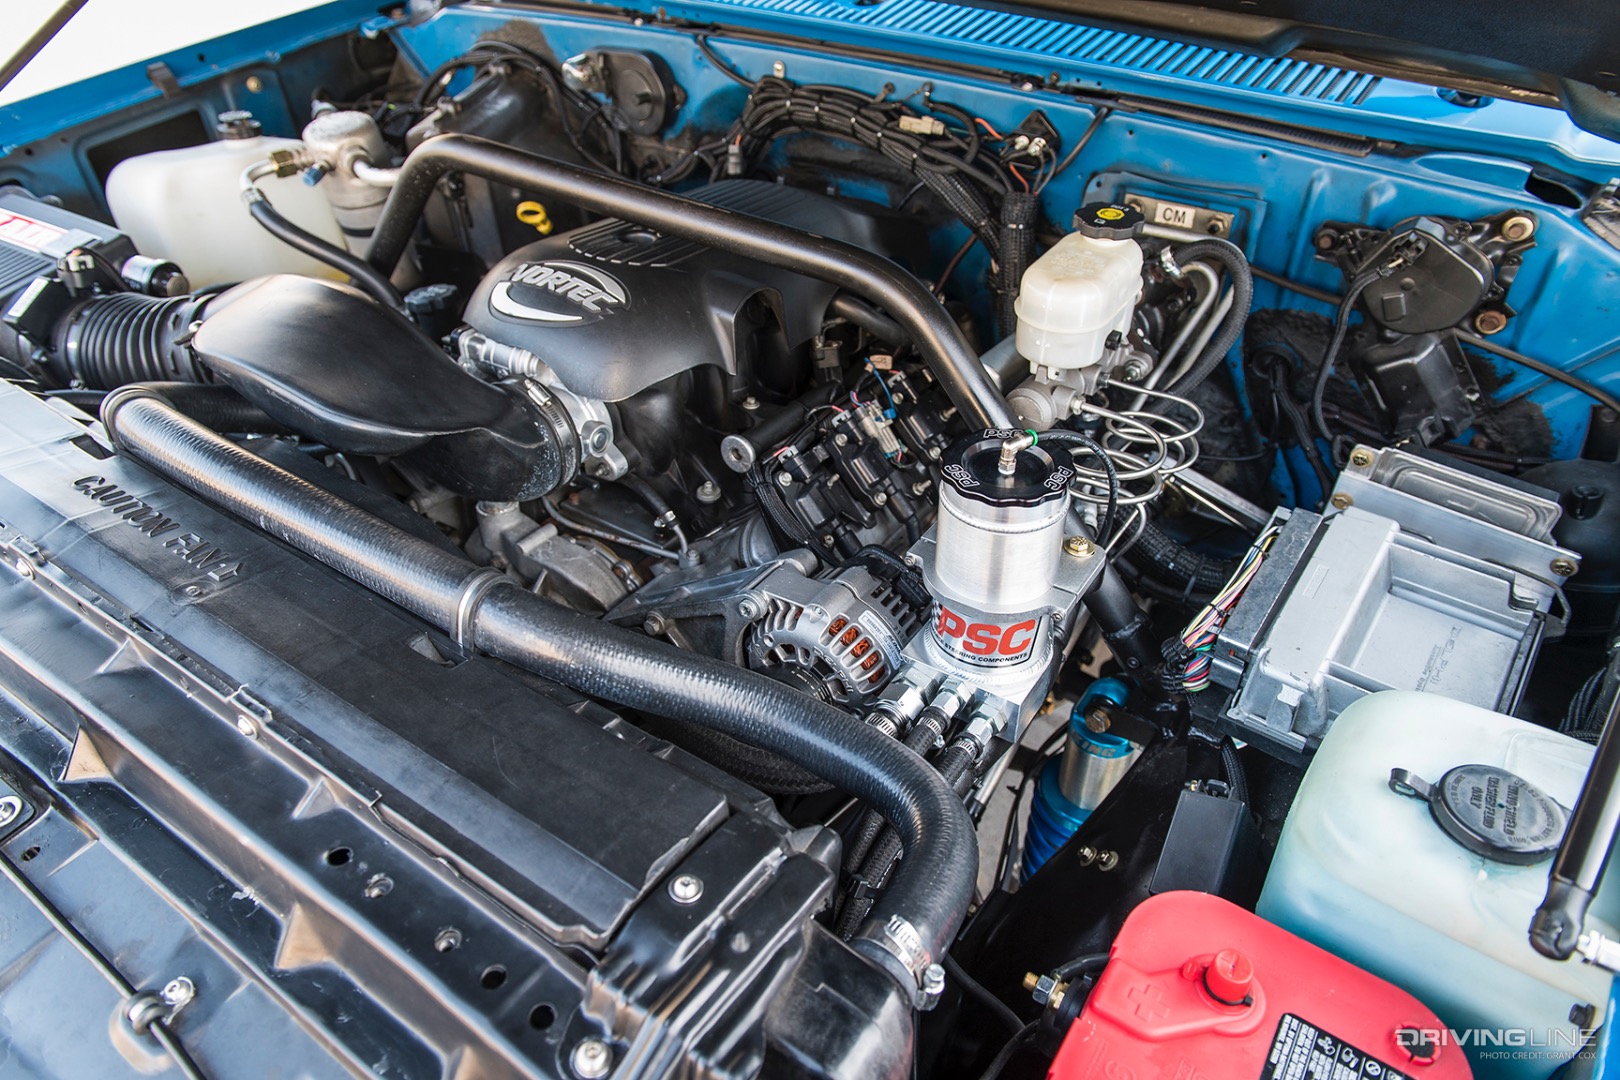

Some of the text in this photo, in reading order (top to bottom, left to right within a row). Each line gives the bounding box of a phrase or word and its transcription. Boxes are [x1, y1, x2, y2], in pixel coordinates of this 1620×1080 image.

[1162, 207, 1186, 225] CM
[511, 263, 619, 315] VORTEC
[944, 464, 980, 488] PSC
[1043, 466, 1074, 491] PSC
[72, 475, 230, 570] CAUTION FAN
[936, 604, 1036, 656] PSC
[977, 652, 1028, 663] COMPONENTS
[1469, 786, 1483, 809] ONLY
[1482, 776, 1501, 829] WASHER FLUID
[1502, 784, 1521, 835] WINDSHIELD
